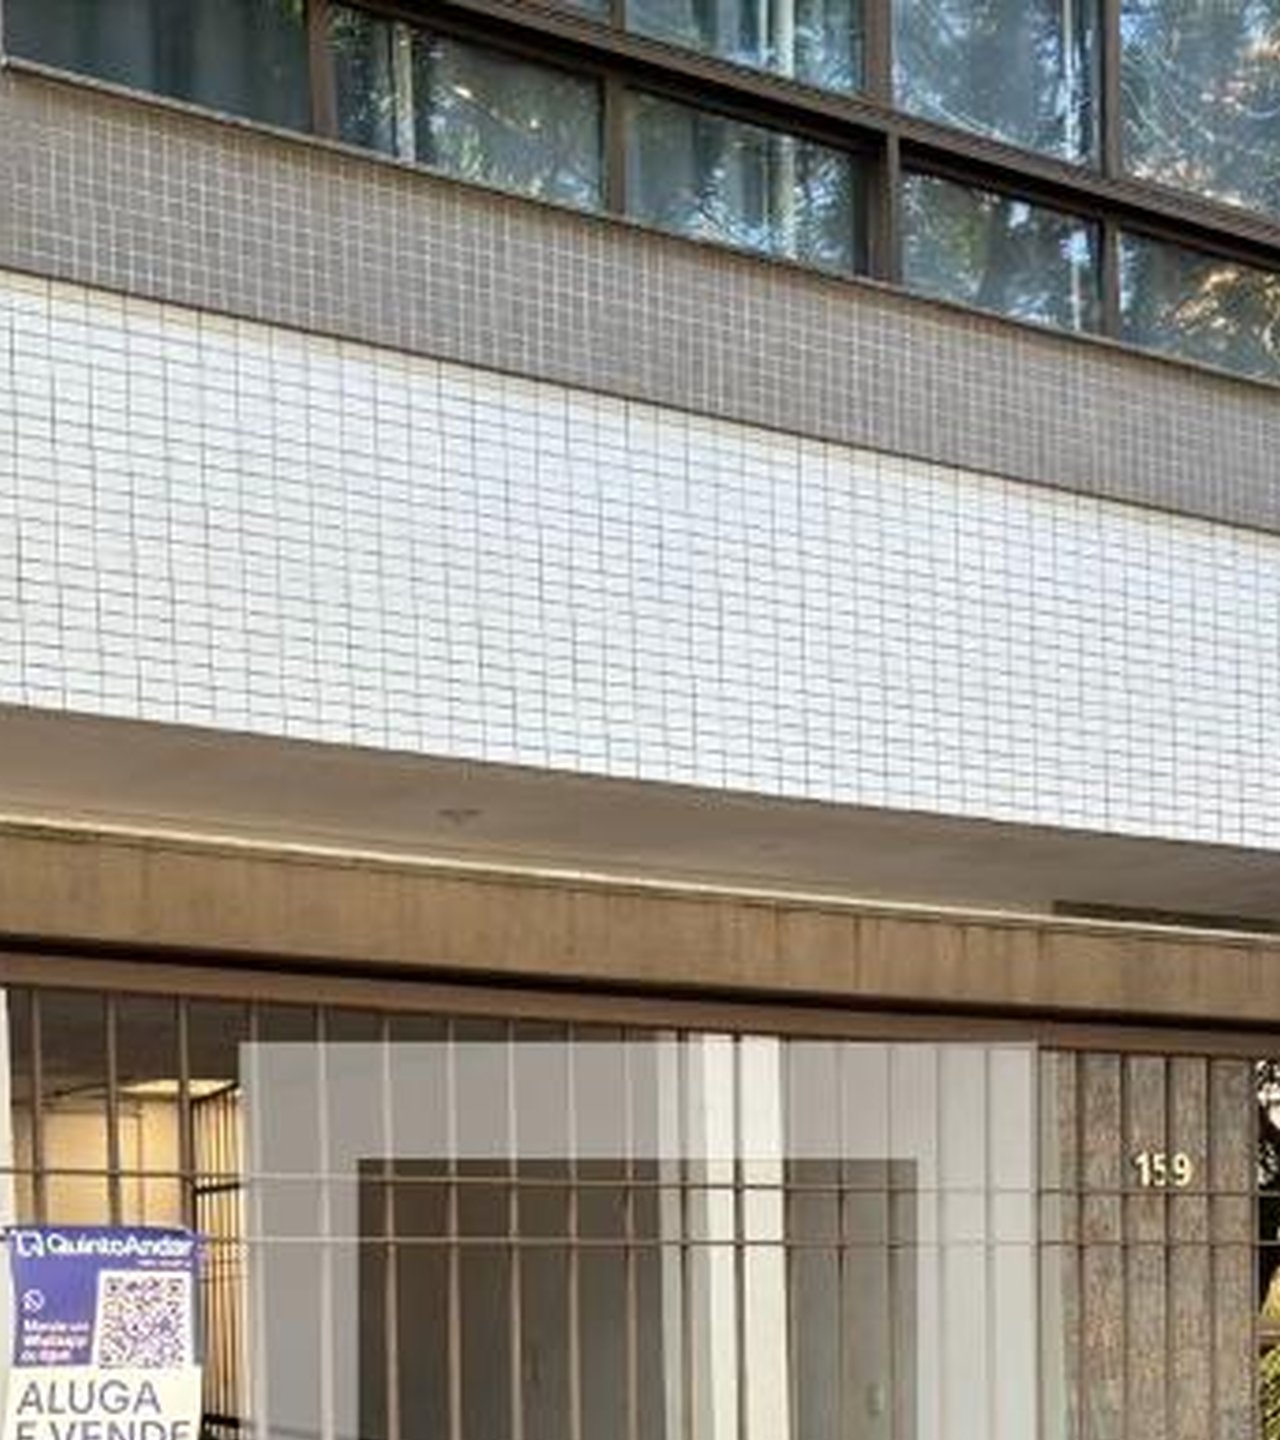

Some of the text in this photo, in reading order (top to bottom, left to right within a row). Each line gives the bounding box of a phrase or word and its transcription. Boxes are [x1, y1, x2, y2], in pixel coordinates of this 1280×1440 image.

[1134, 1150, 1193, 1188] 159
[46, 1231, 194, 1257] QuintoAndar
[15, 1379, 162, 1415] ALUGA
